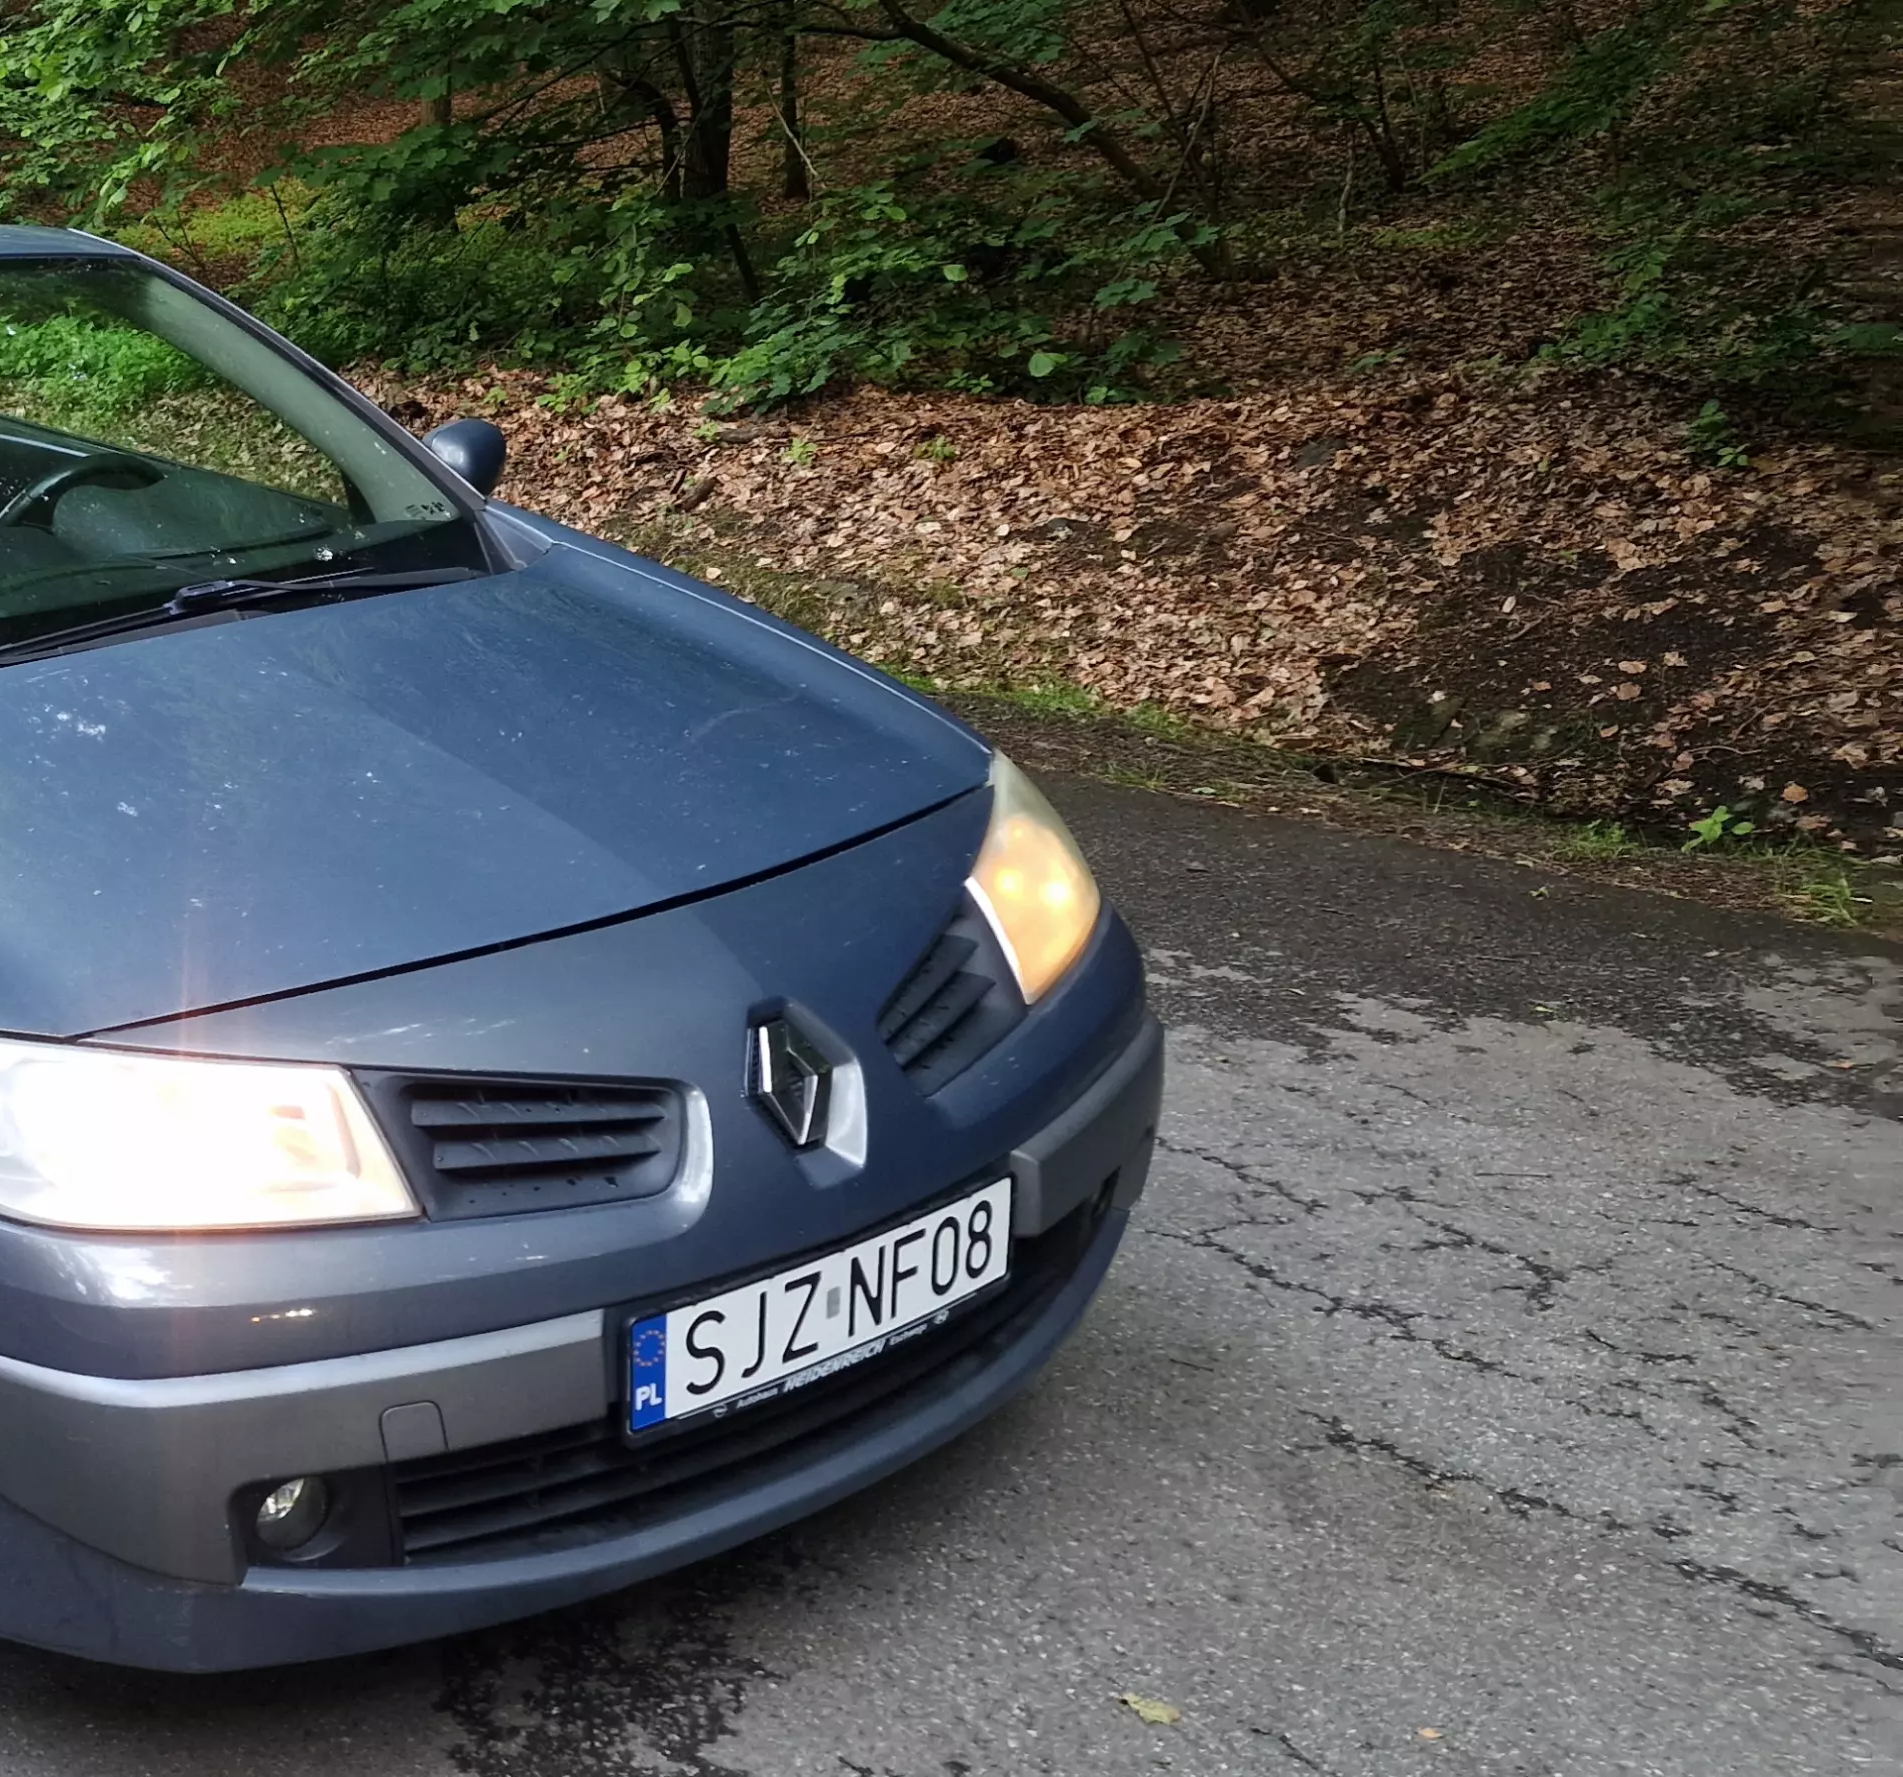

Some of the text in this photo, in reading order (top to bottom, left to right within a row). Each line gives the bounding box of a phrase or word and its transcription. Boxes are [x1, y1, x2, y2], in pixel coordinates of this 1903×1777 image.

[685, 1199, 993, 1395] SJZ NF08
[634, 1383, 663, 1412] PL
